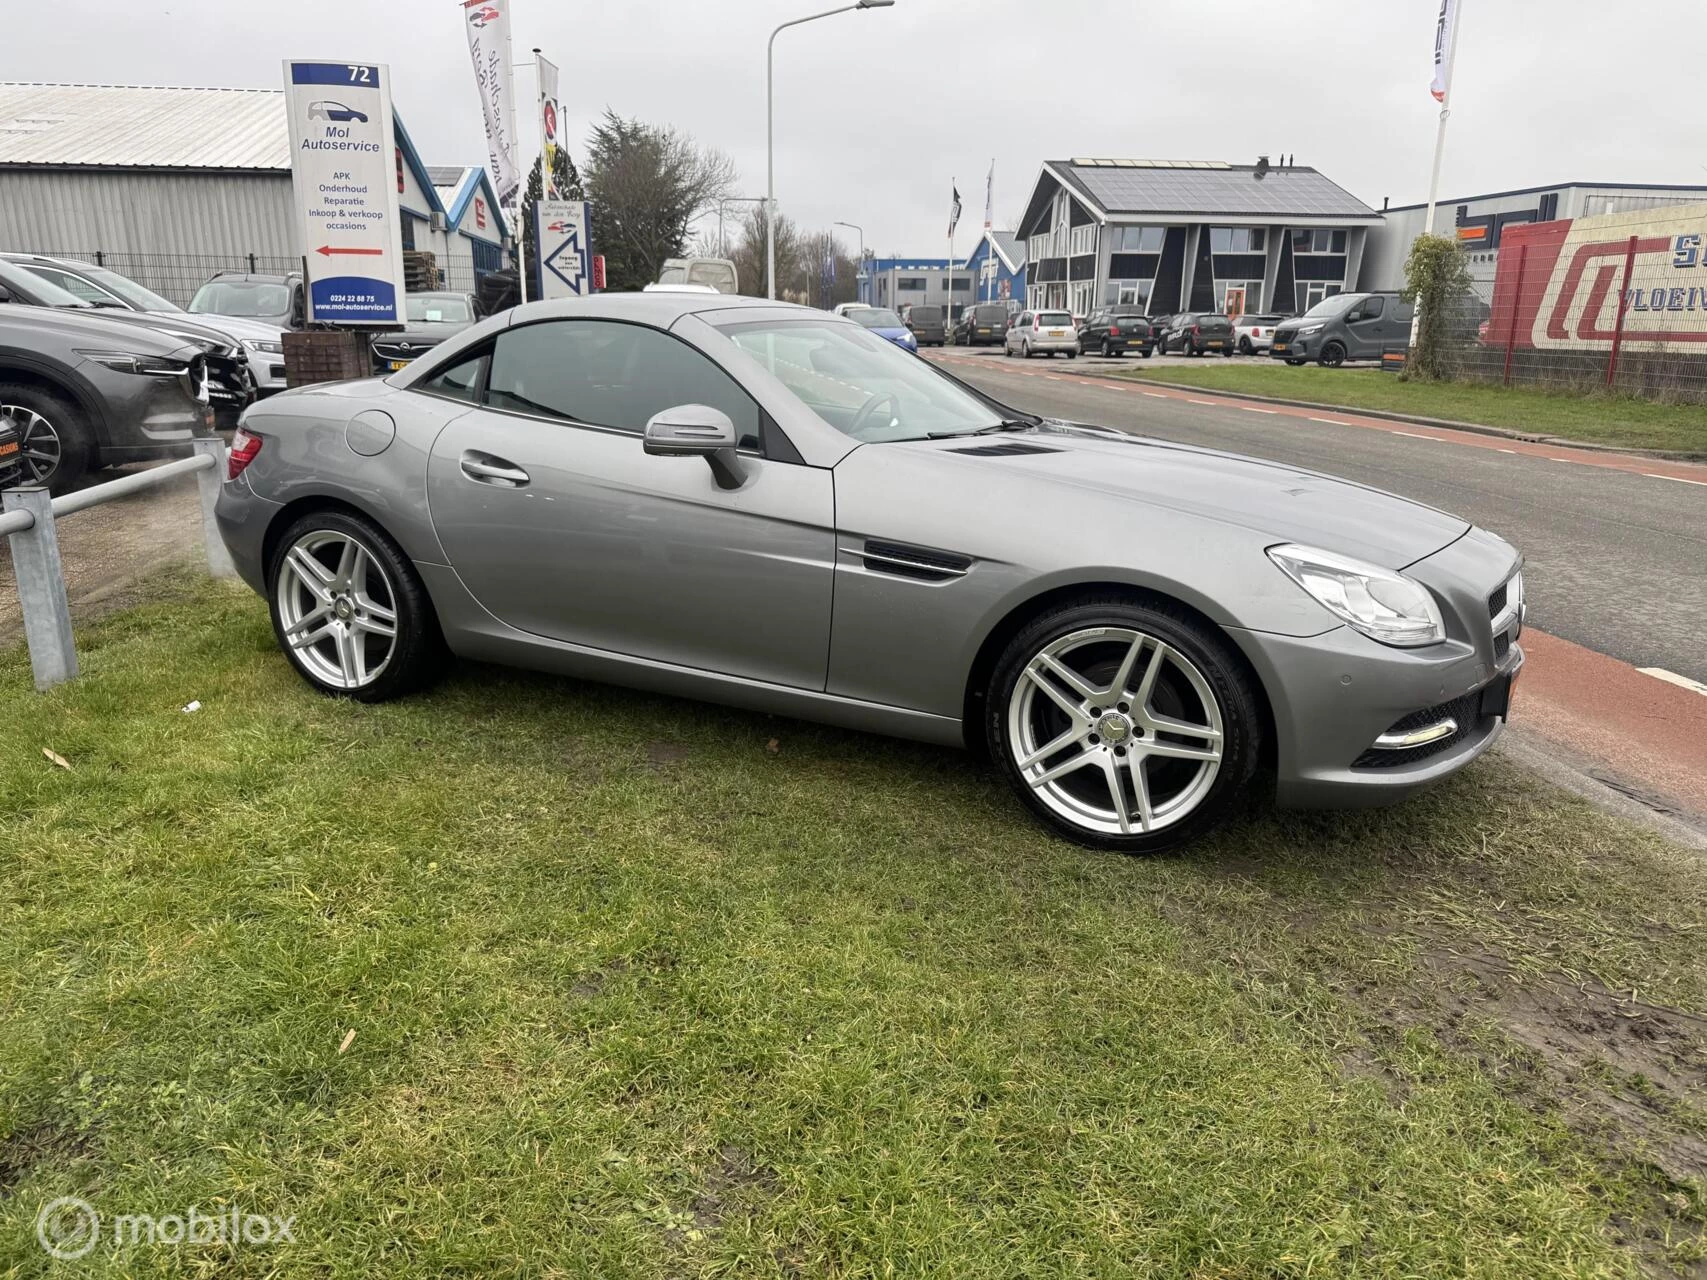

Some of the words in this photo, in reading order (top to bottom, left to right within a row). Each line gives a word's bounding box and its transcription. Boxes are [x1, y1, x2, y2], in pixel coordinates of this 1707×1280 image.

[347, 66, 371, 83] 72
[325, 126, 349, 139] Mol
[301, 138, 380, 153] Autoservice
[333, 172, 351, 181] APK
[318, 183, 368, 194] Onderhoud
[323, 196, 365, 207] Reparatie
[308, 209, 337, 219] Inkoop
[338, 209, 346, 218] &
[348, 210, 384, 220] verkoop
[326, 221, 367, 230] occasions
[1673, 233, 1707, 269] S
[330, 294, 346, 302] 0224
[347, 294, 356, 302] 22
[366, 294, 375, 302] 75
[315, 303, 393, 312] www.mol-autoservice.nl
